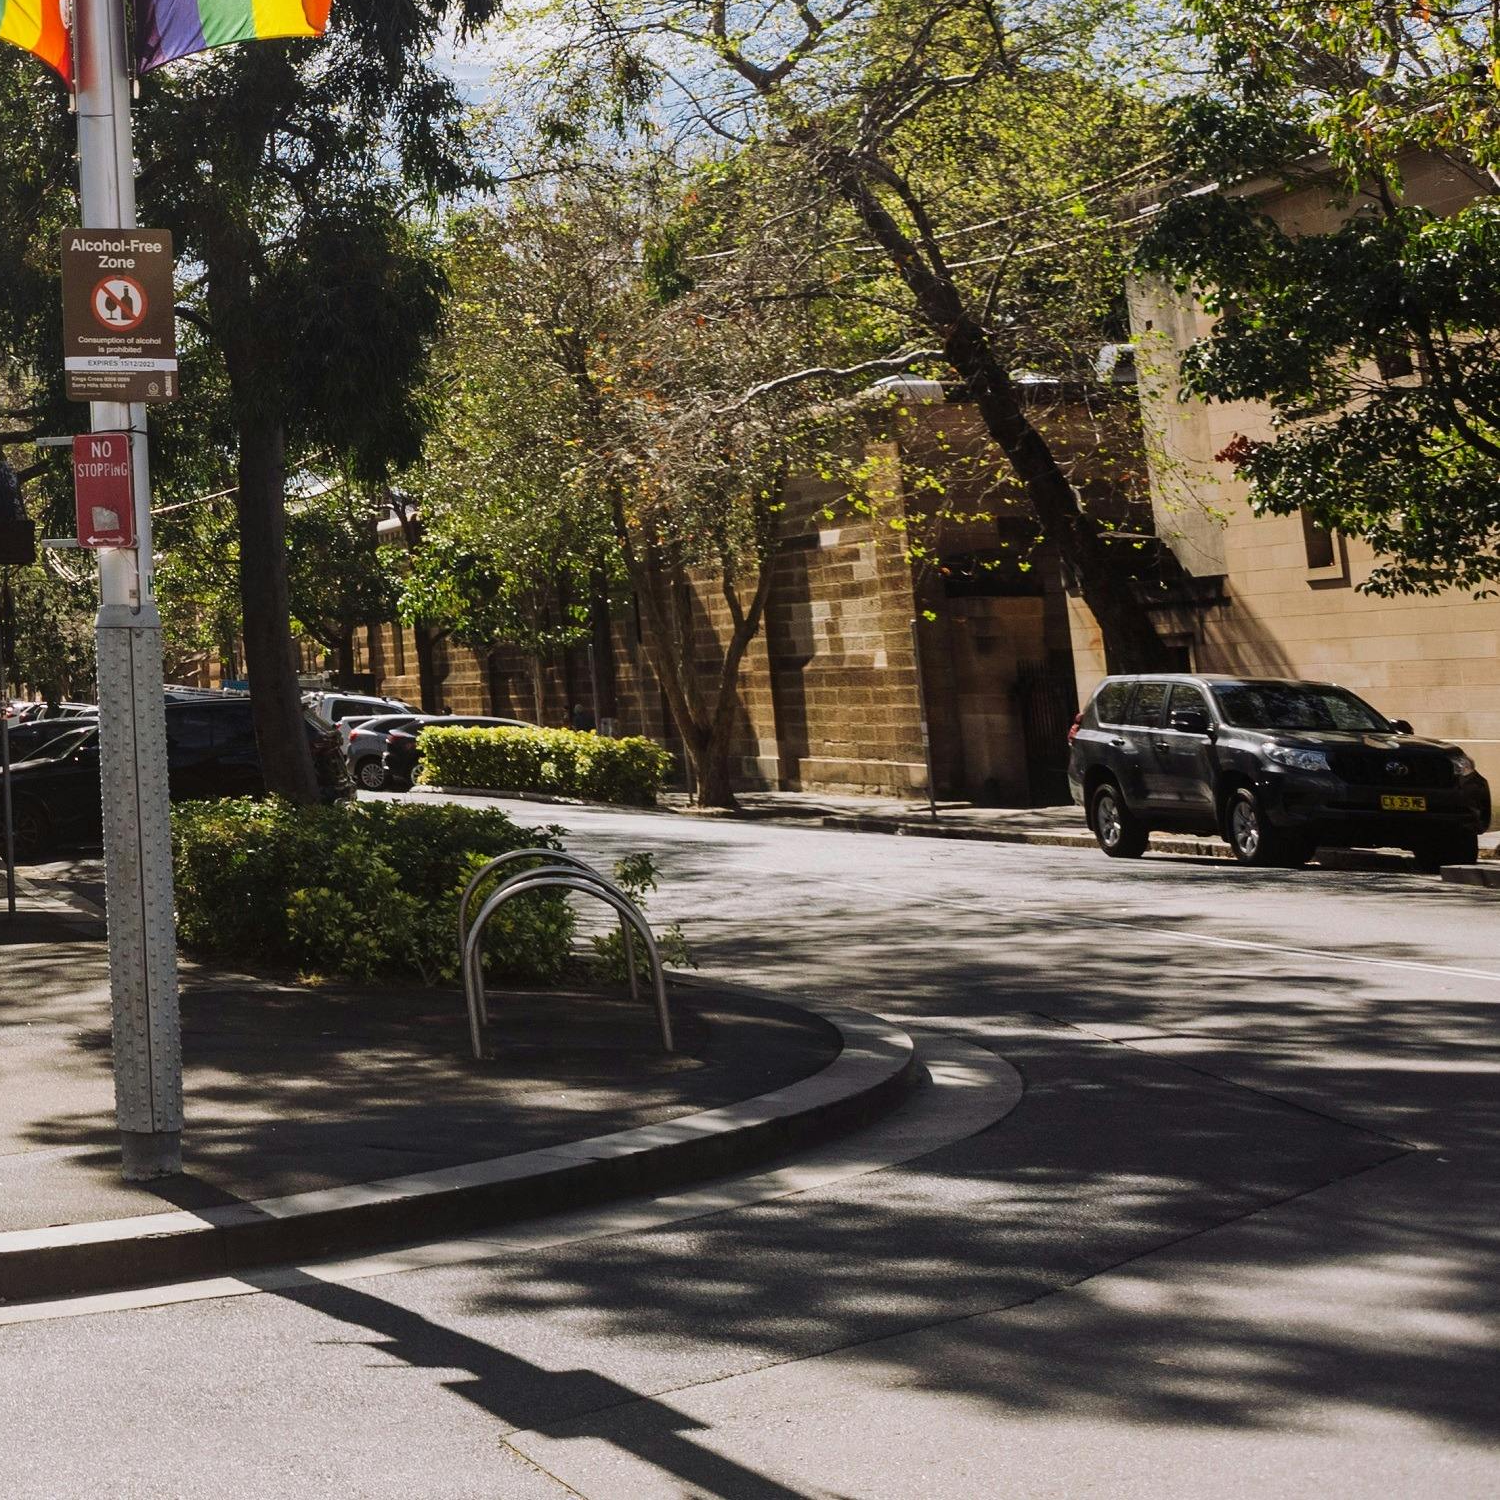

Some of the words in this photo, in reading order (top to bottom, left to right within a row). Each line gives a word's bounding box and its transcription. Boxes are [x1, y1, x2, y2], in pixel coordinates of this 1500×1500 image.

[70, 238, 162, 253] Alcohol-Free
[98, 255, 136, 269] Zone
[78, 335, 125, 345] Consumption
[135, 337, 162, 345] alcohol
[98, 345, 105, 353] is
[106, 346, 142, 354] prohibited
[87, 359, 119, 367] EXPIRES
[91, 440, 112, 458] NO
[77, 462, 128, 478] STOPPING
